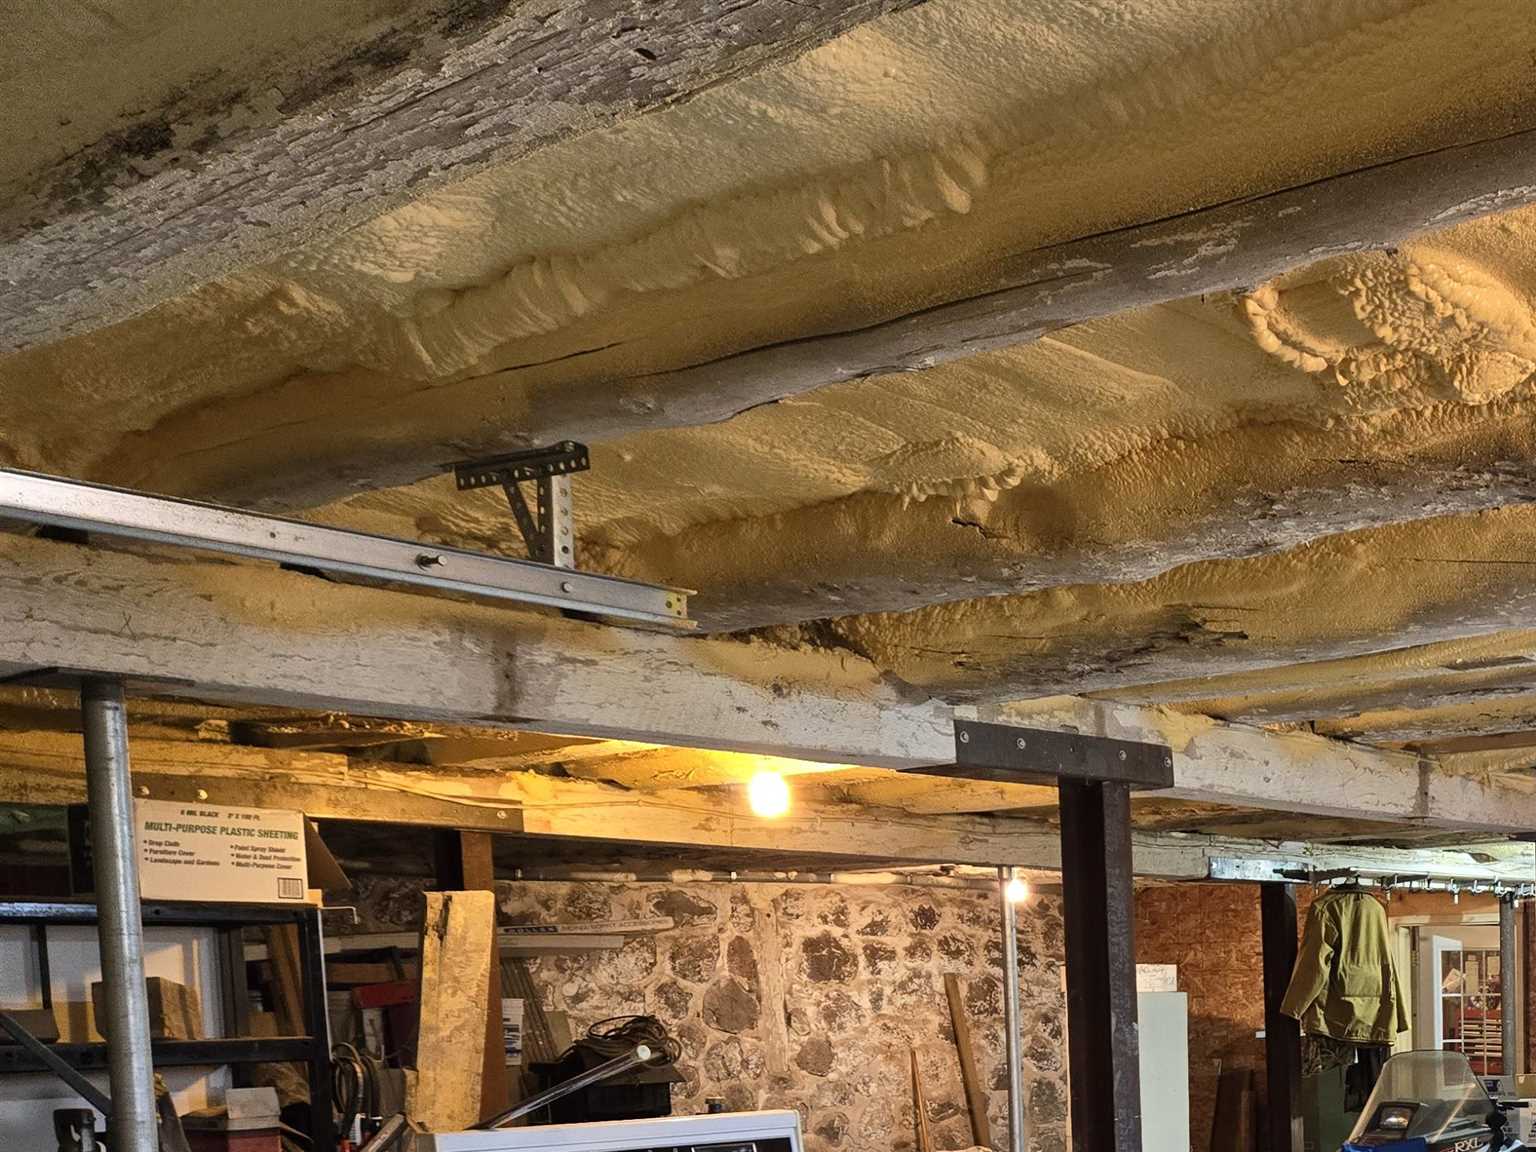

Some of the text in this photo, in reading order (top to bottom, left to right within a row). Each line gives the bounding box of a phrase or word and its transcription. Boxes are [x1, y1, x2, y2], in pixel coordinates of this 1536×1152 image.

[144, 821, 299, 841] MULTI-PURPOSE PLASTIC SHEETING
[148, 839, 163, 848] Drop
[149, 848, 177, 856] Furniture
[150, 857, 182, 865] Landscape
[235, 861, 276, 870] Multi-Purpose
